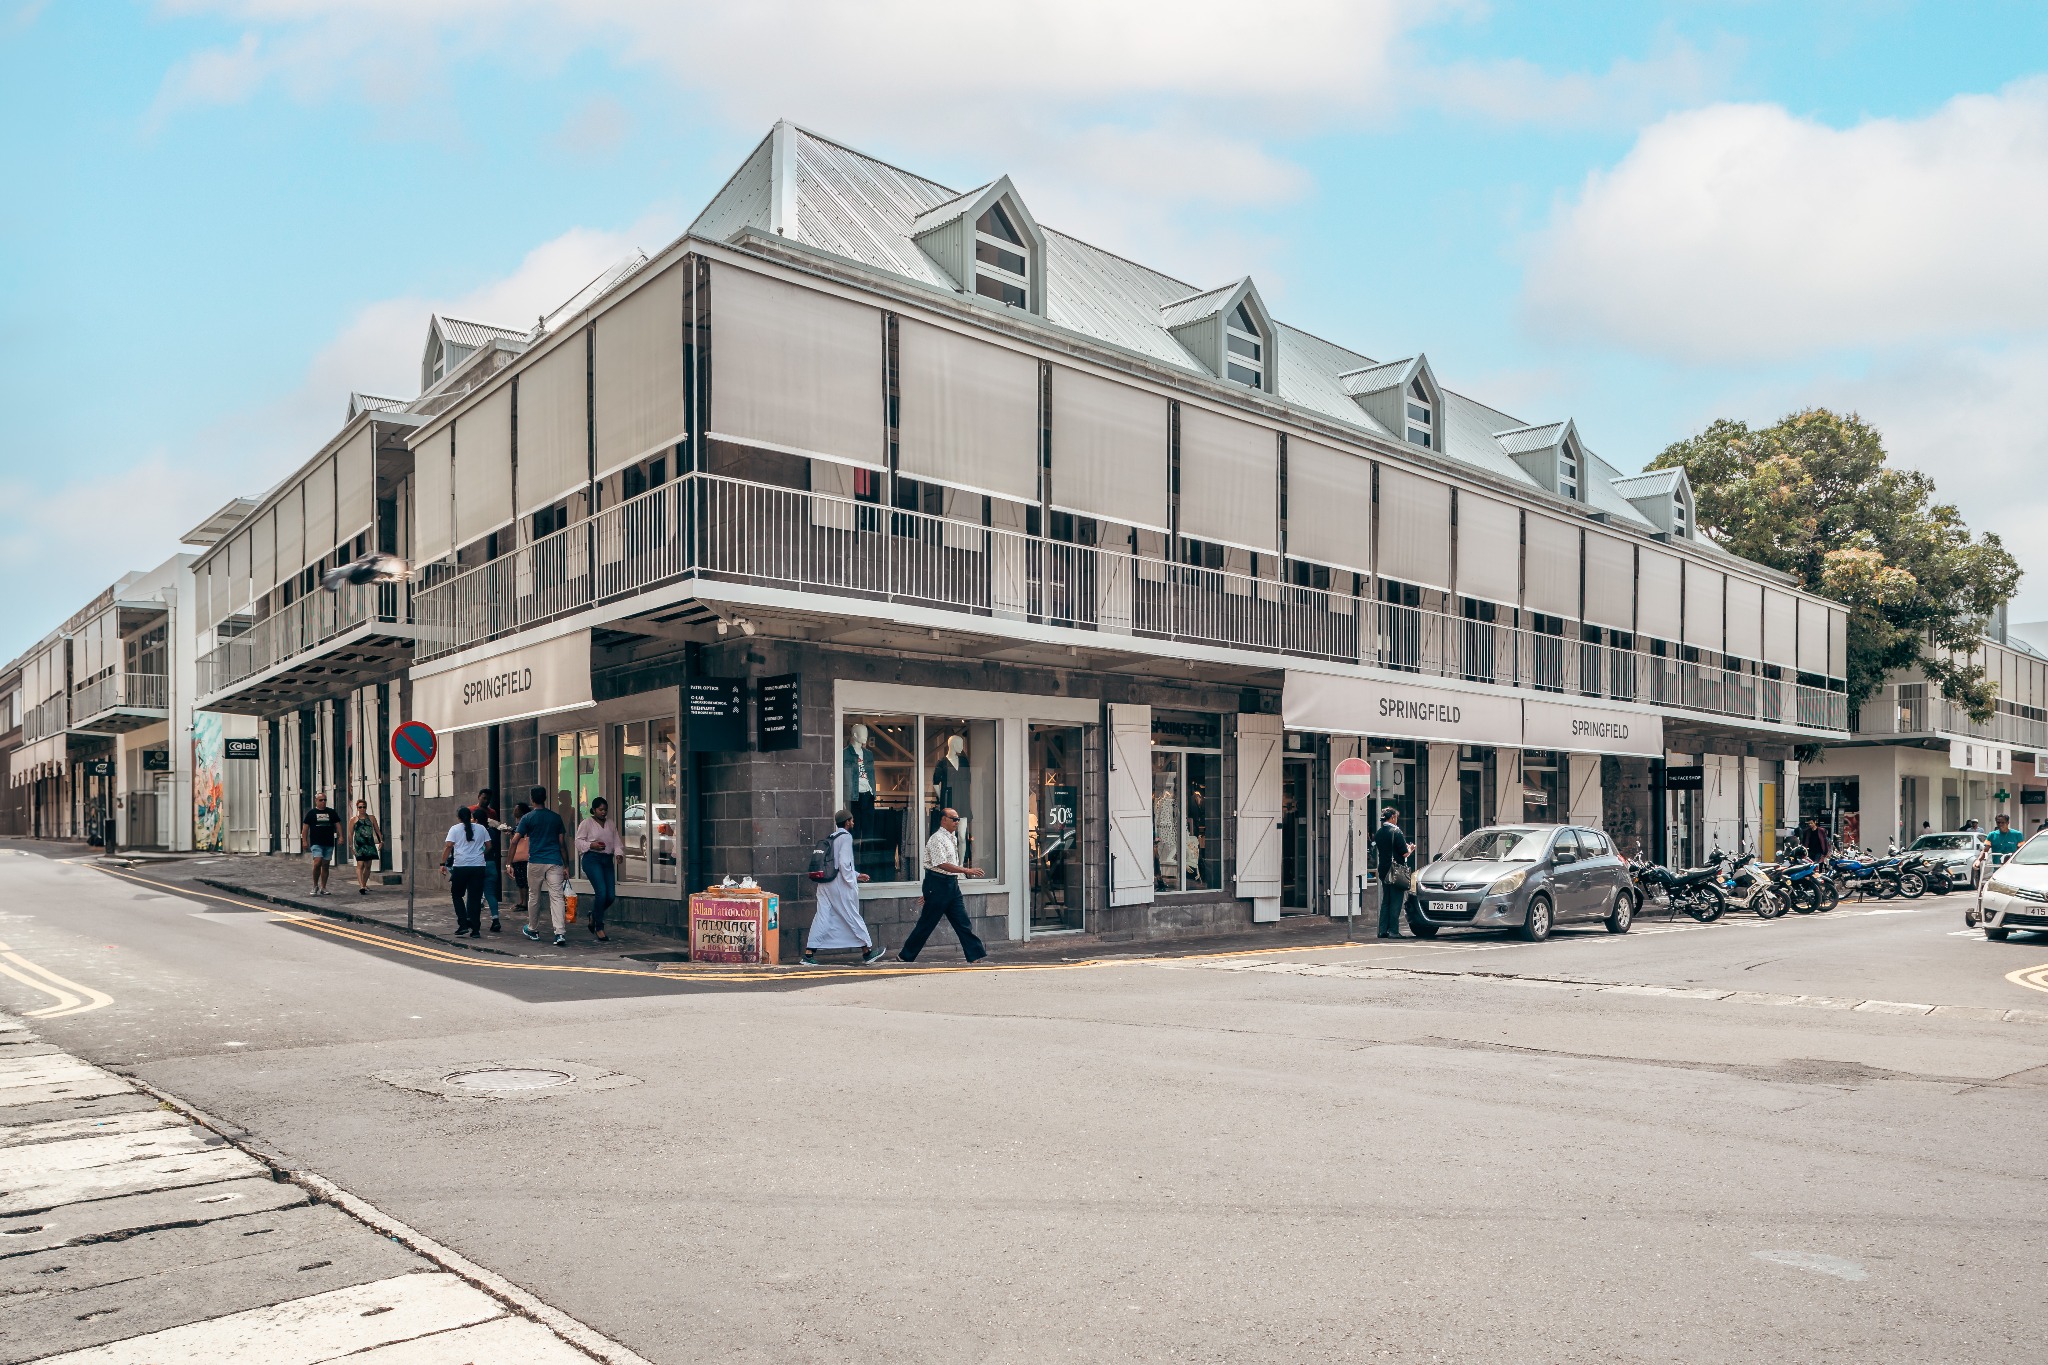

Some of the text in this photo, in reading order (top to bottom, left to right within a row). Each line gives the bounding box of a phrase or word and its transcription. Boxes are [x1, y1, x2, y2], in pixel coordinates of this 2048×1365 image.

[463, 667, 532, 706] SPRINGFIELD
[1379, 697, 1461, 724] SPRINGFIELD
[1572, 719, 1629, 739] SPRINGFIELD
[1049, 807, 1073, 825] 50%
[2030, 908, 2046, 916] 415
[696, 920, 755, 932] TATOUAGE
[702, 934, 747, 944] PIERCING
